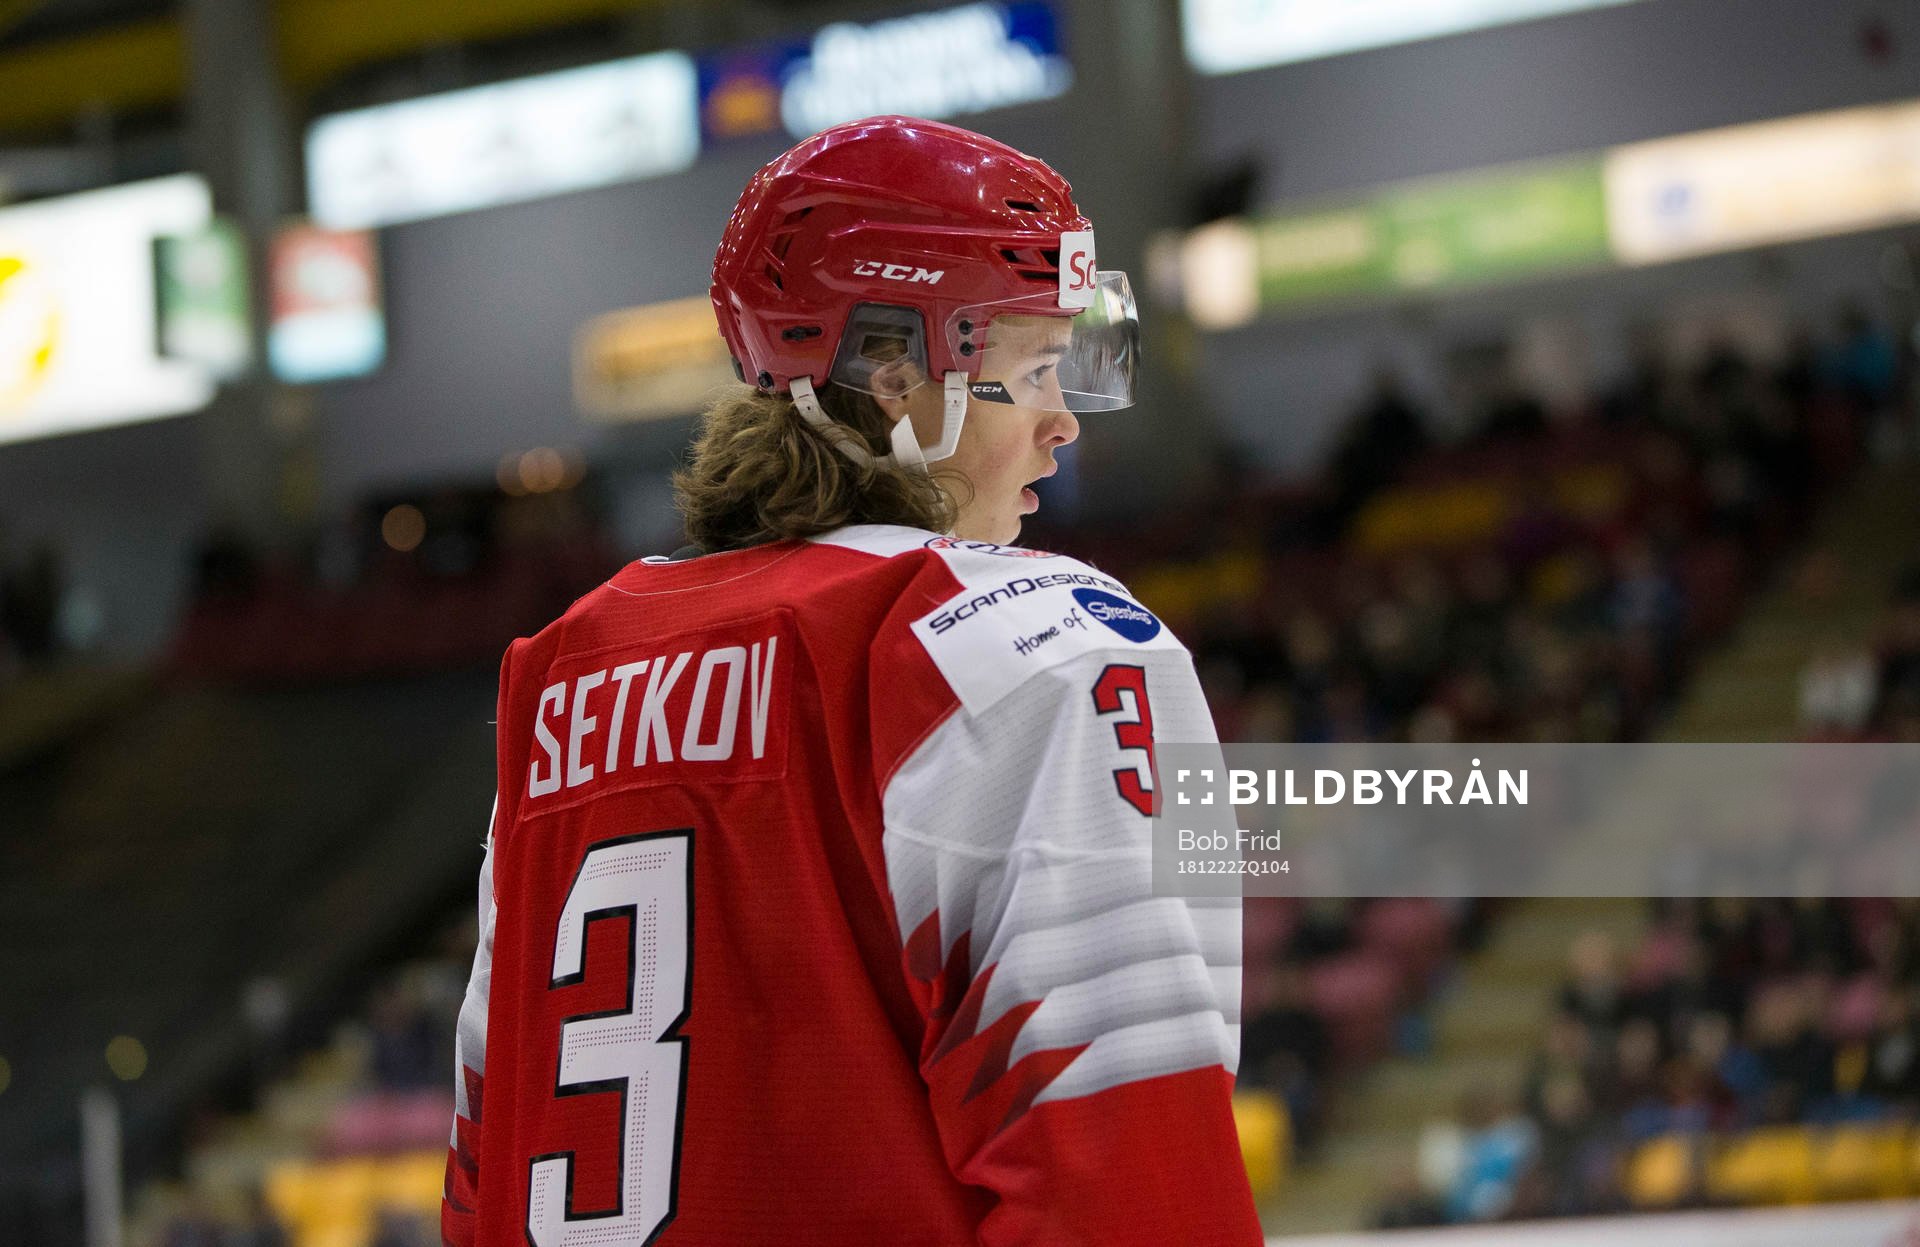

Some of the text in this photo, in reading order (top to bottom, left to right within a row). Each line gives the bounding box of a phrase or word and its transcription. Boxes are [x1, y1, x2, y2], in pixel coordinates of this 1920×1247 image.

[853, 258, 945, 285] CCM
[972, 385, 1003, 393] CCM
[1013, 607, 1088, 656] Home of
[529, 636, 778, 799] SETKOV
[1091, 663, 1163, 818] 3
[525, 827, 696, 1247] 3
